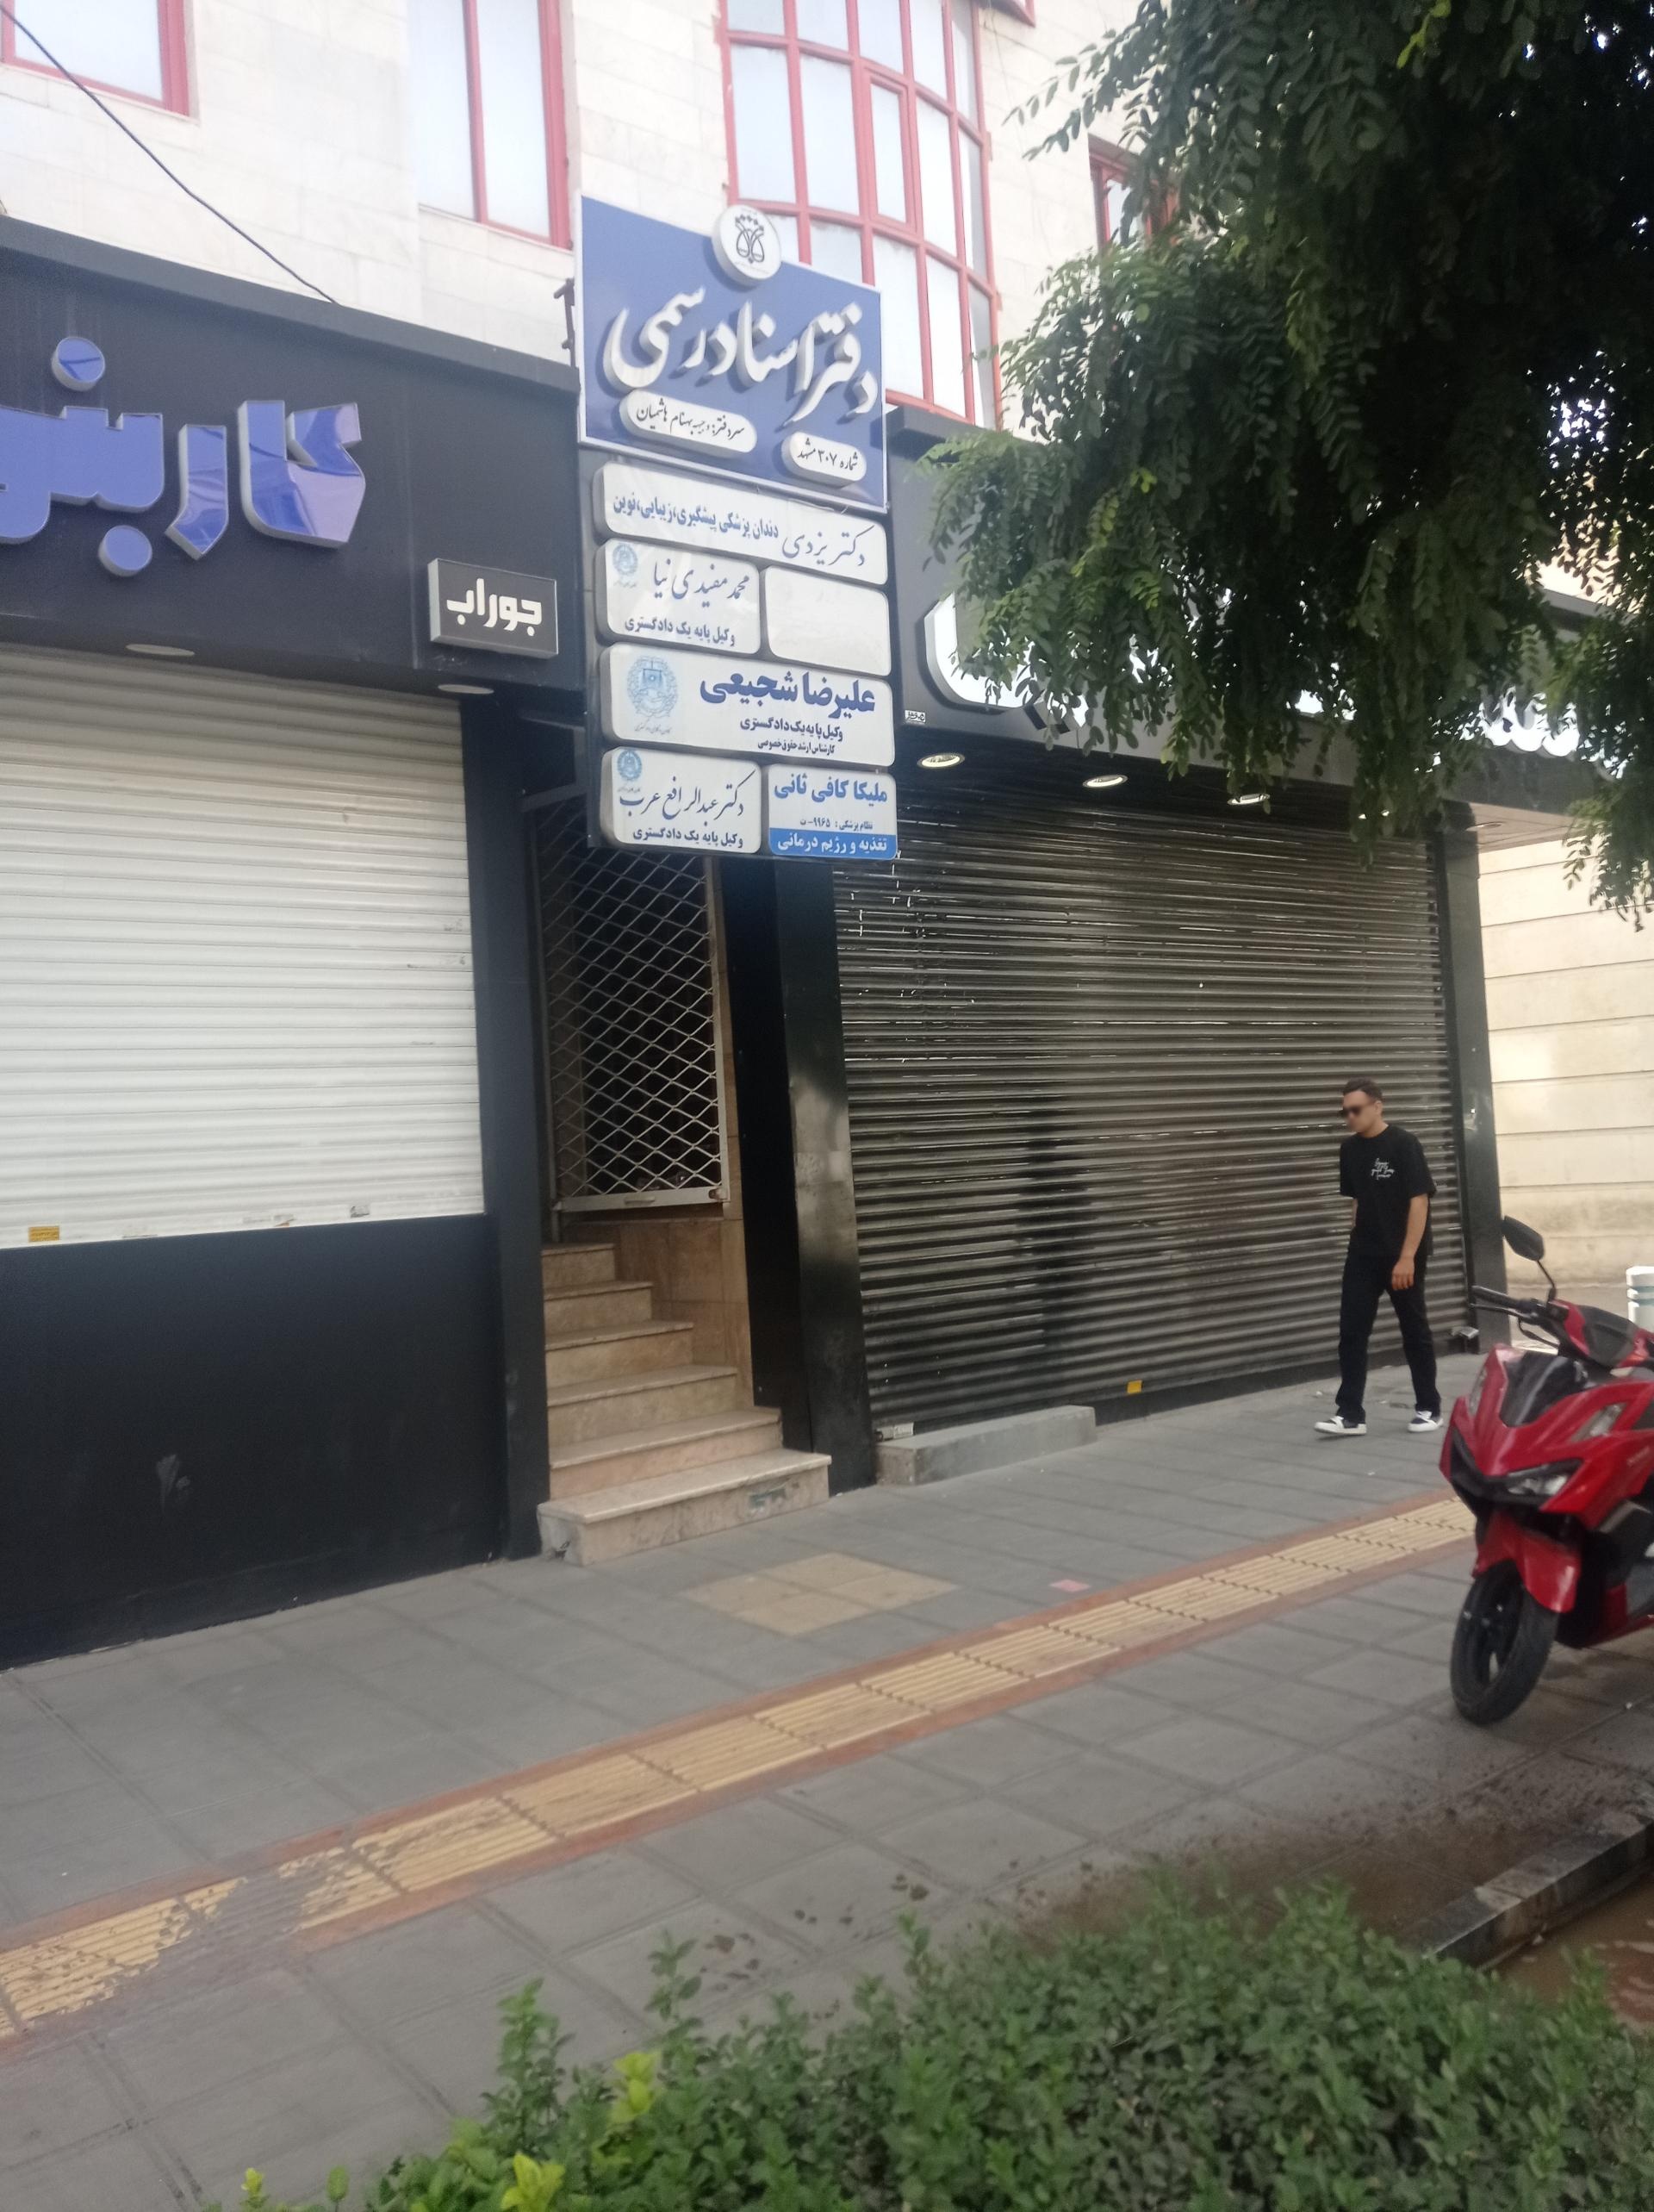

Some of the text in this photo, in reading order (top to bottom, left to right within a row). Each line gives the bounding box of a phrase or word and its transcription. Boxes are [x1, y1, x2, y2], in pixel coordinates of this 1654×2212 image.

[604, 286, 879, 427] دفتر اسناد رسمی
[636, 397, 668, 430] هاشمیان
[797, 437, 859, 471] شماره ۳۰۷ مشهد
[781, 531, 828, 566] یزدی
[827, 524, 875, 567] دکتر
[726, 575, 750, 600] محمد
[446, 577, 542, 637] جوراب
[675, 621, 692, 639] یک
[693, 624, 712, 643] پایه
[712, 626, 735, 647] وکیل
[700, 670, 876, 720] علیرضا شجیعی
[823, 726, 843, 742] وکیل
[713, 770, 756, 820] دکتر
[774, 771, 887, 807] ملیکا کافی ثانی
[619, 791, 662, 817] عرب
[683, 830, 700, 844] یک
[702, 831, 718, 847] پایه
[720, 832, 743, 848] وکیل
[777, 831, 887, 854] تغذیه و رژیم درمانی
